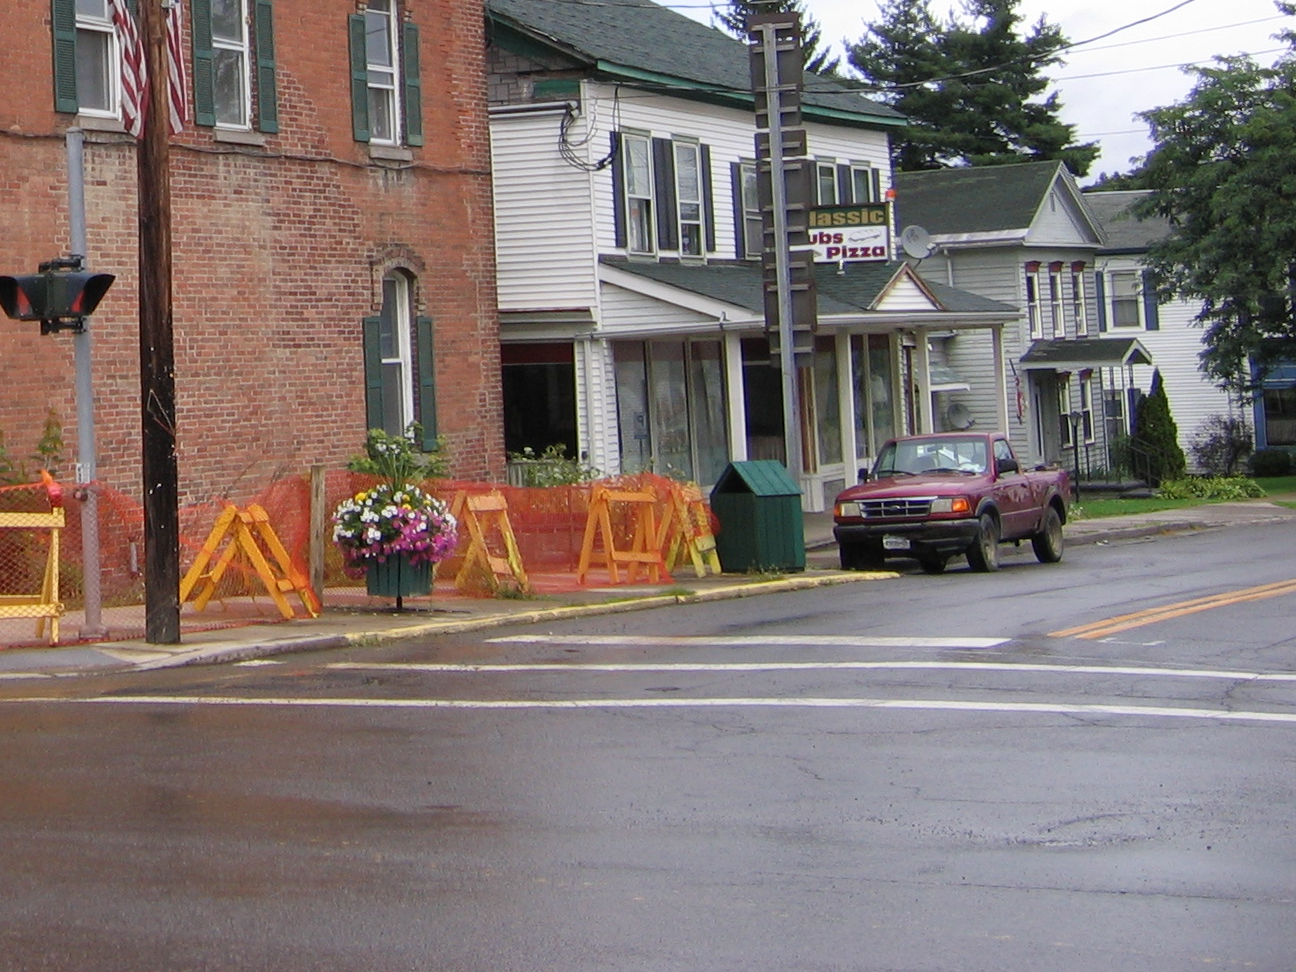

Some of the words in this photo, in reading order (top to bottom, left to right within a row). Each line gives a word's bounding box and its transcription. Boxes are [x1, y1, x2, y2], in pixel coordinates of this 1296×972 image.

[809, 208, 885, 227] lassic
[809, 231, 844, 245] ubs
[826, 245, 886, 260] Pizza
